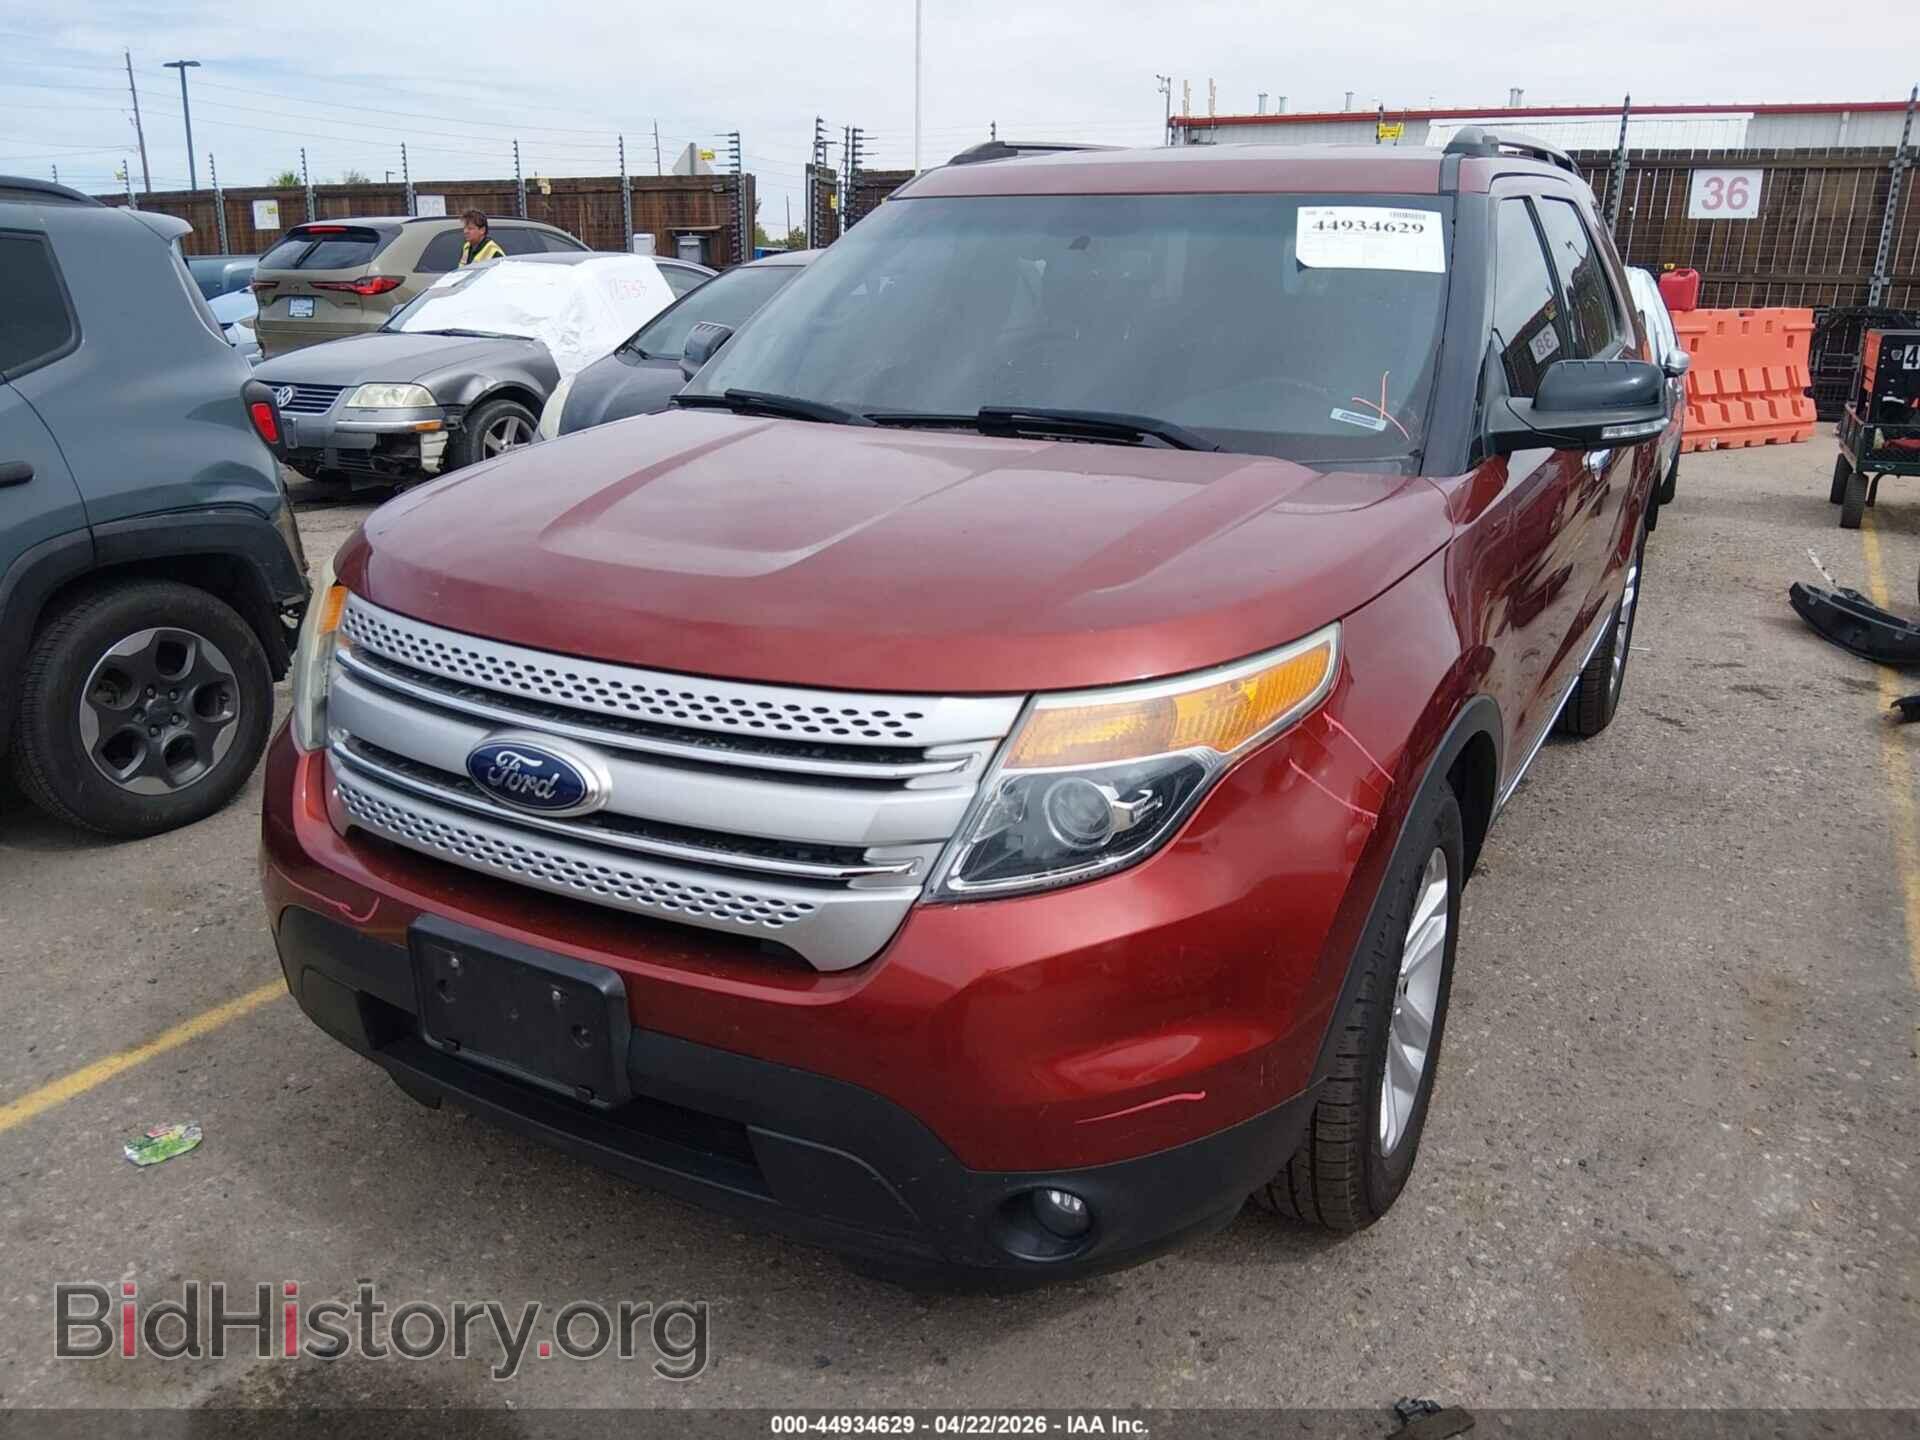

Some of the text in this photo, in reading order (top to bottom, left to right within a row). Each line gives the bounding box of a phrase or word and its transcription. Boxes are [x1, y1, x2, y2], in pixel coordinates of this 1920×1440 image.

[1701, 176, 1749, 210] 36
[1311, 219, 1425, 234] 44934629
[486, 750, 561, 799] Ford
